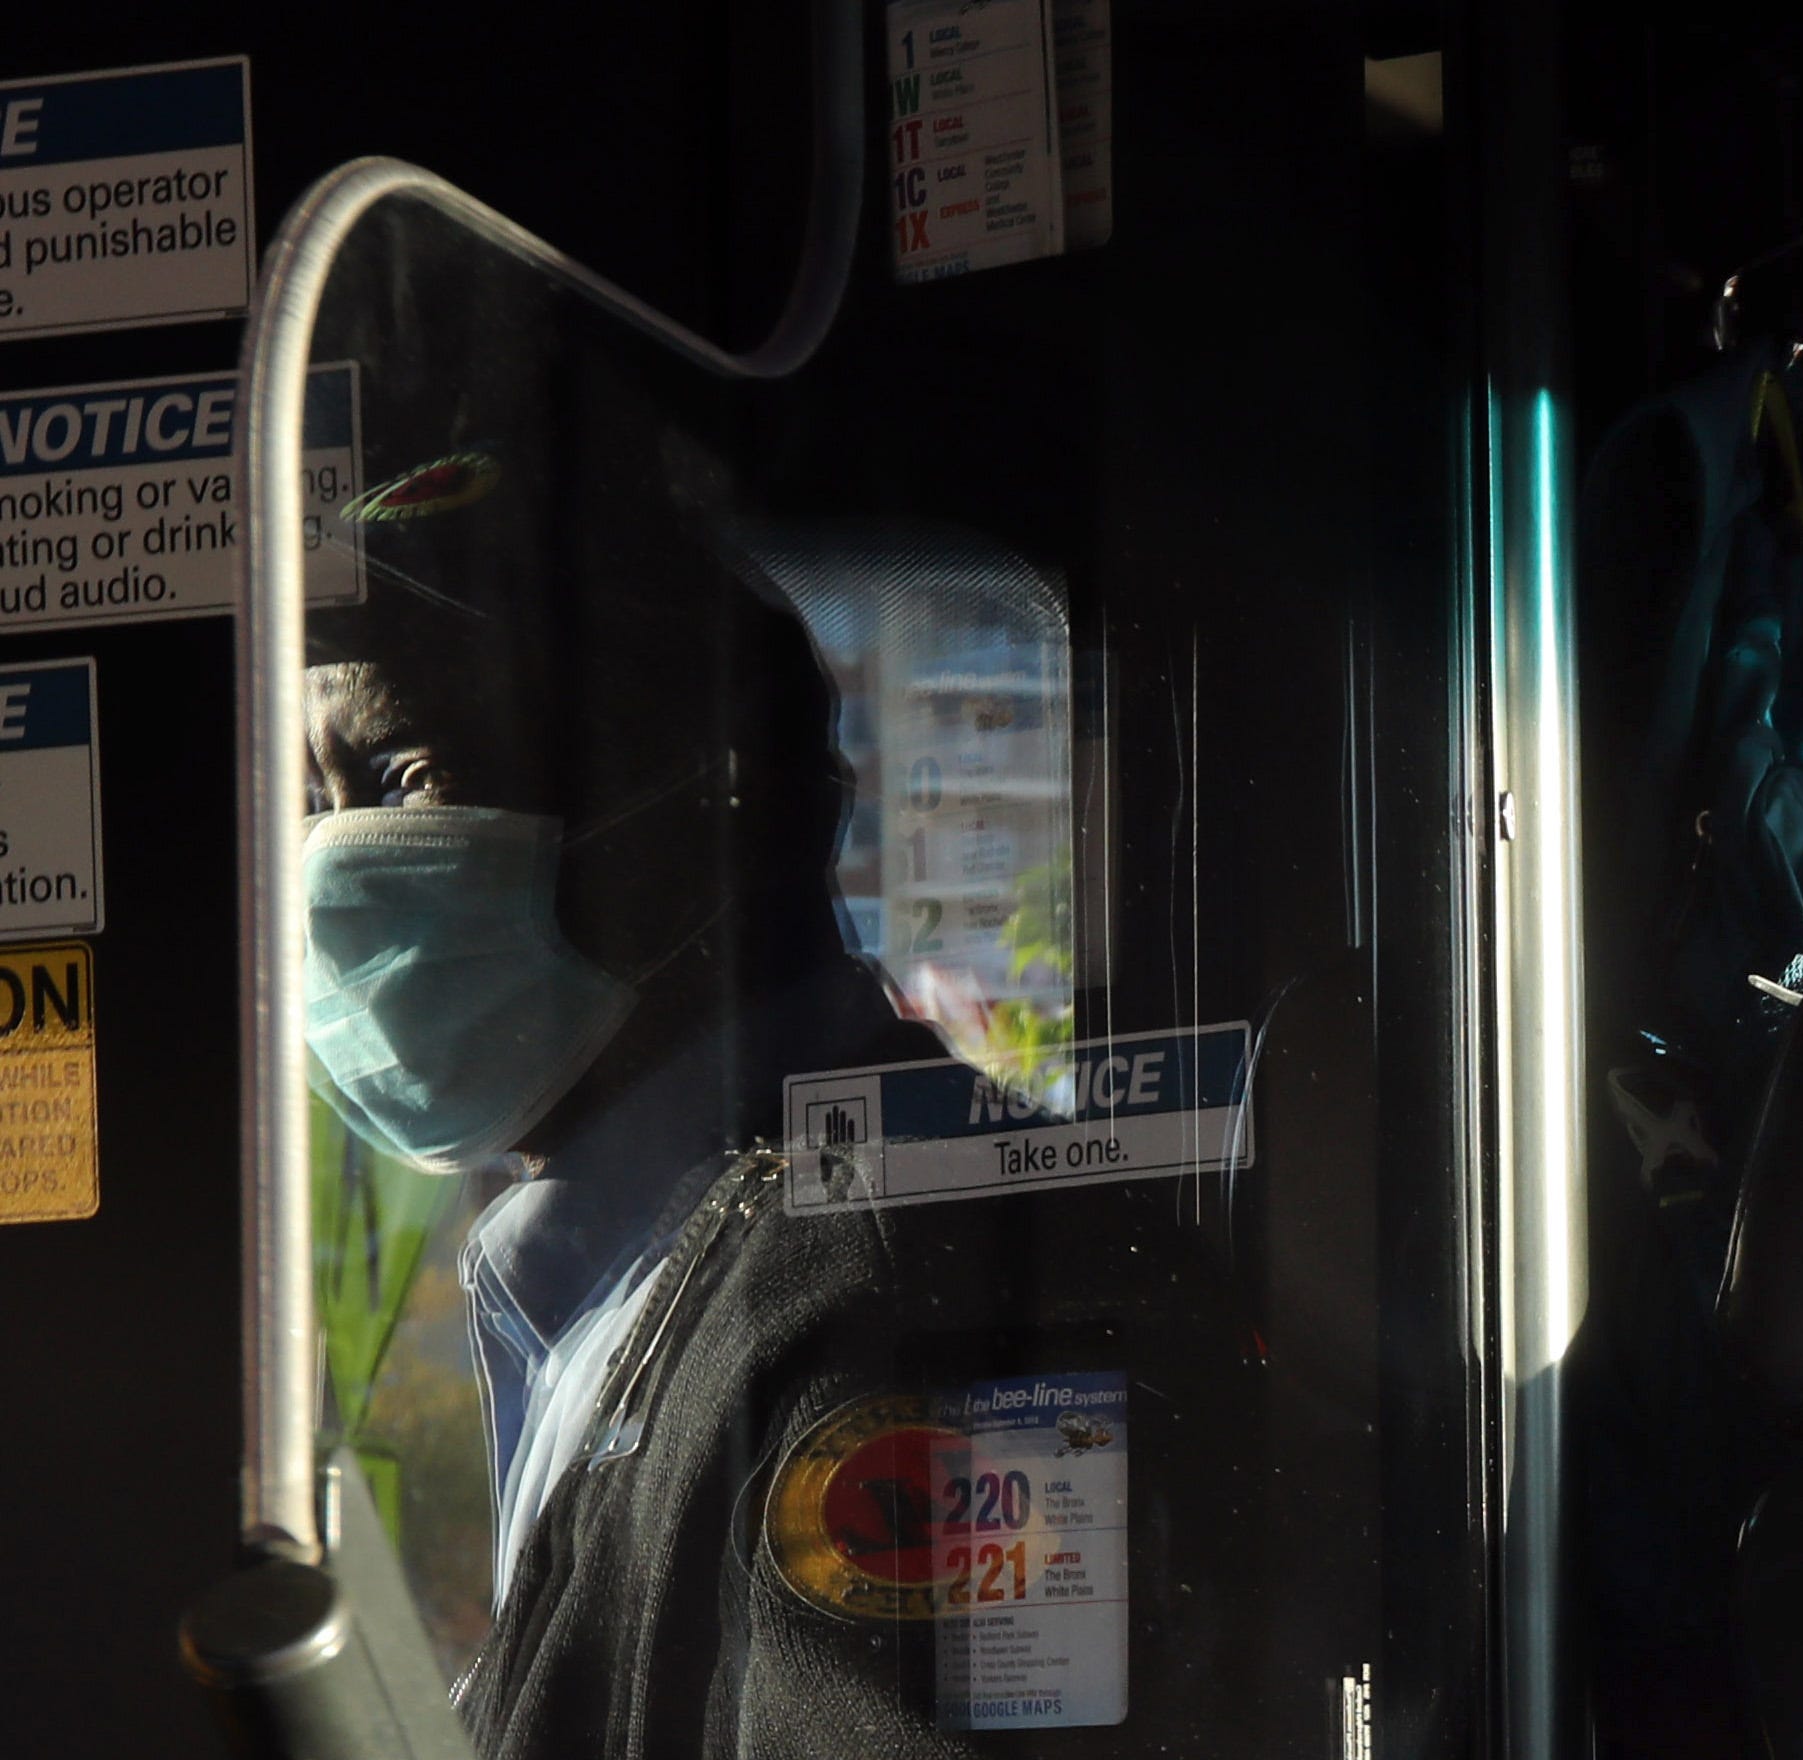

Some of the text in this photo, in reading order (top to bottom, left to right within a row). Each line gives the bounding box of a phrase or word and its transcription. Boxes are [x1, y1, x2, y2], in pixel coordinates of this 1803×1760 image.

[929, 26, 962, 43] LOCAL
[930, 68, 963, 86] LOCAL
[933, 116, 964, 133] LOCAL
[893, 120, 923, 163] 1T
[937, 165, 966, 182] LOCAL
[63, 167, 228, 221] operator
[895, 167, 926, 210] 1C
[25, 210, 237, 274] punishable
[896, 210, 931, 254] 1X
[136, 480, 176, 508] or
[91, 531, 131, 559] or
[60, 566, 177, 608] audio.
[968, 1050, 1167, 1125] NOICE
[993, 1137, 1129, 1176] Take one.
[990, 1381, 1074, 1412] bee-line
[1074, 1389, 1128, 1408] system
[1045, 1481, 1073, 1494] LOCAL
[1044, 1551, 1082, 1566] LIMITED
[973, 1699, 1063, 1720] GOOGLE MAPS
